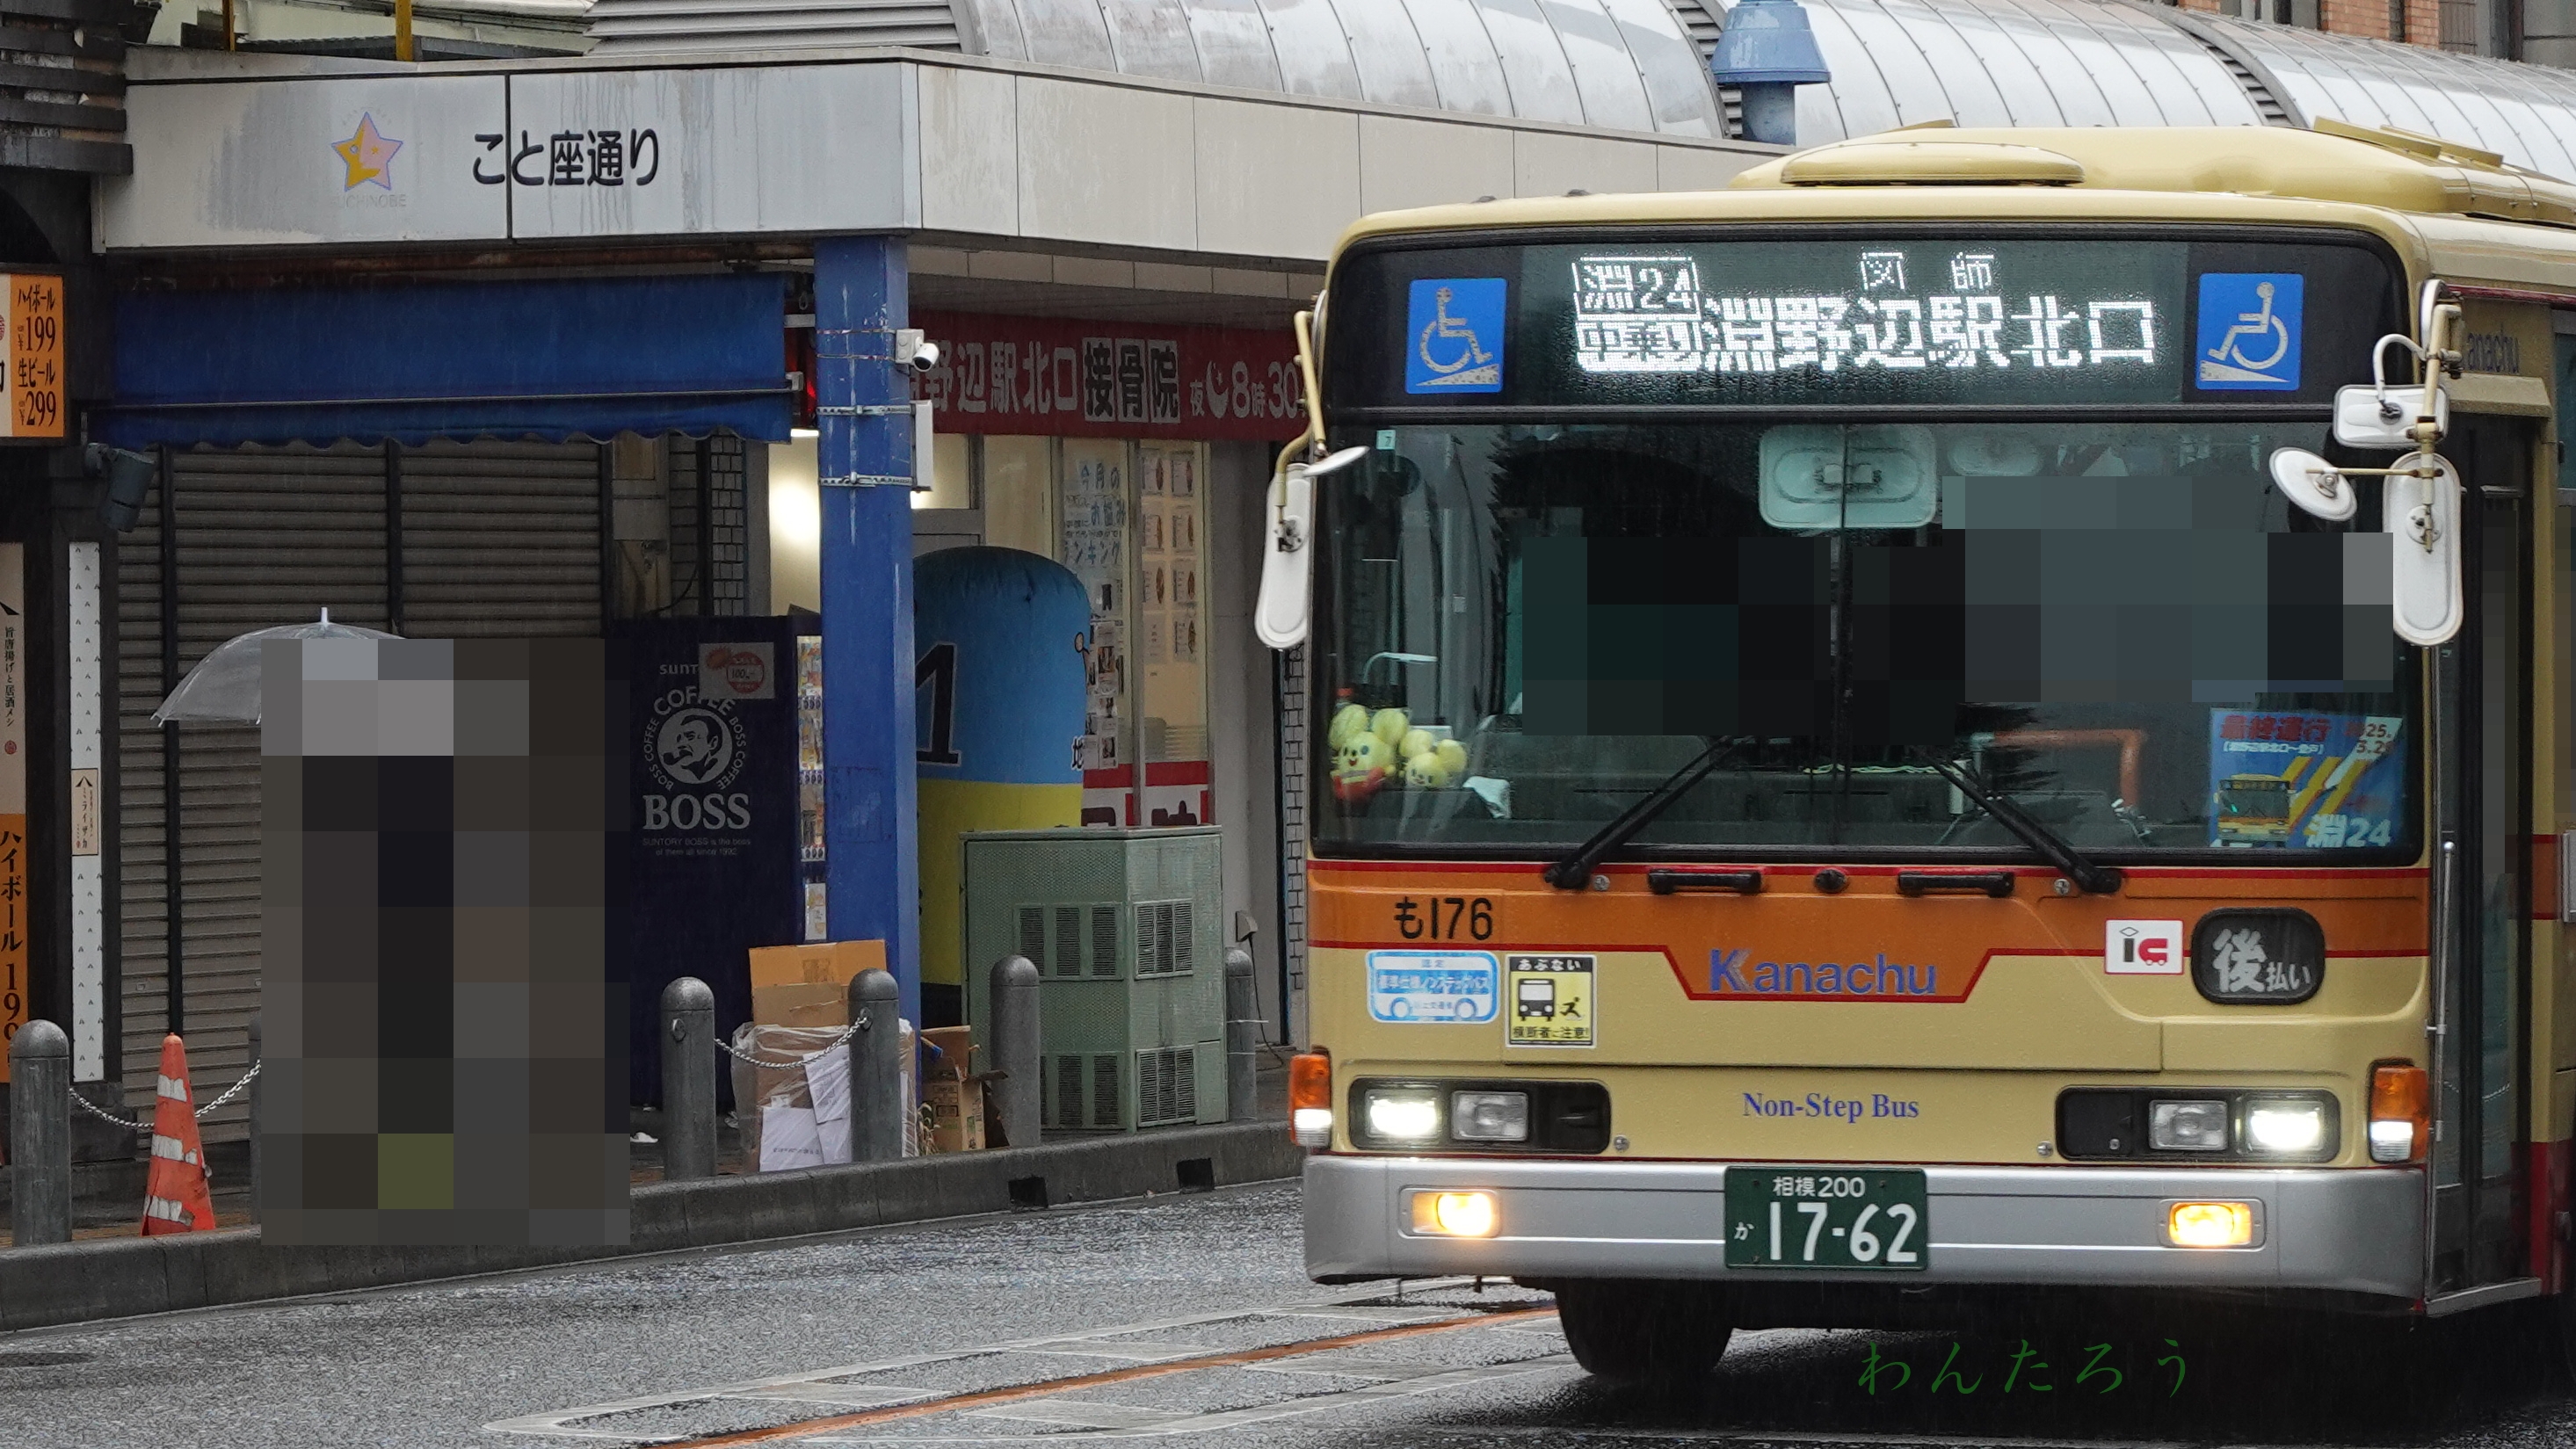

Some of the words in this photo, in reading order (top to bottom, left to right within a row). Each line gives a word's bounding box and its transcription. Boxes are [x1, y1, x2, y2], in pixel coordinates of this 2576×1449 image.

[473, 128, 658, 186] こと座通り
[18, 284, 56, 313] ハイボール
[1702, 296, 2155, 371] 淵野辺駅北口
[2467, 322, 2520, 373] anachu
[18, 357, 56, 388] 生ビール
[911, 339, 1078, 414] 野辺駅北口
[1084, 340, 1179, 419] 接骨院
[1231, 360, 1307, 419] 8時30
[642, 793, 751, 830] BOSS
[0, 830, 24, 953] ハイボール
[1394, 895, 1493, 941] も176
[1518, 958, 1582, 971] あぶない
[1709, 948, 1937, 995] Kanachu
[2212, 928, 2311, 993] 後払い
[4, 963, 21, 1068] 199
[1743, 1092, 1864, 1124] Non-Step
[1871, 1094, 1919, 1119] Bus
[1773, 1177, 1866, 1199] 相模200
[1733, 1221, 1755, 1242] か
[1769, 1201, 1918, 1263] 17-62
